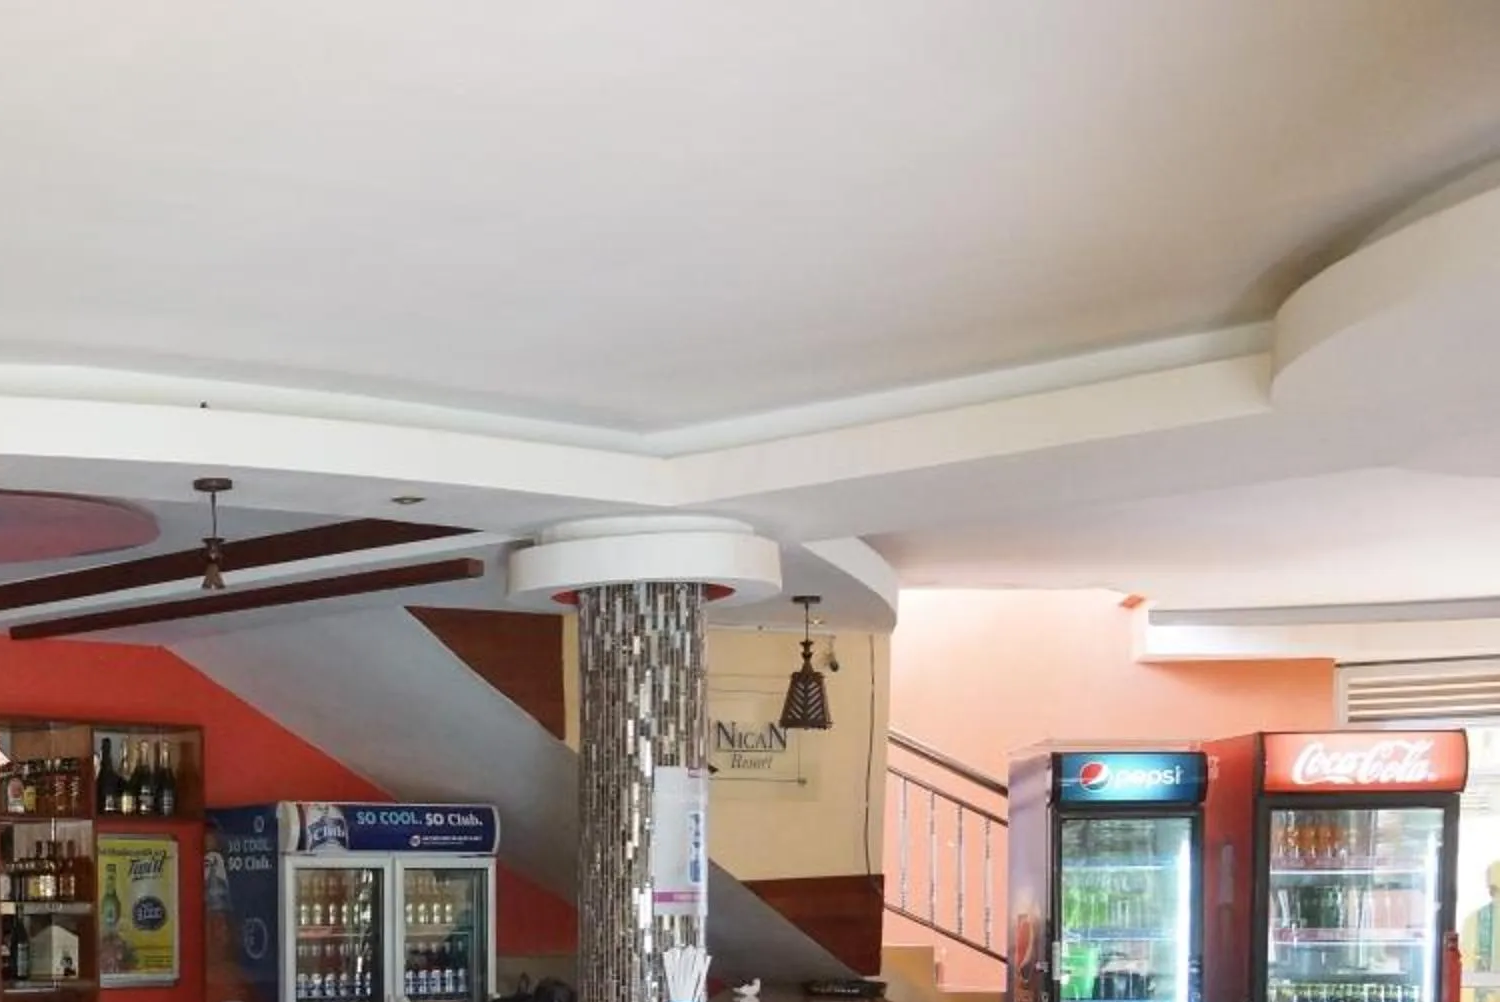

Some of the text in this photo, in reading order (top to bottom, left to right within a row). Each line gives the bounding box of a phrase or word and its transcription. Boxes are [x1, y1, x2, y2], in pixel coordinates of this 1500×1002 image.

[1293, 739, 1432, 785] Coca-Cola
[1113, 766, 1183, 791] pepsi
[355, 810, 376, 826] SO
[425, 812, 445, 827] SO
[228, 855, 243, 871] SO
